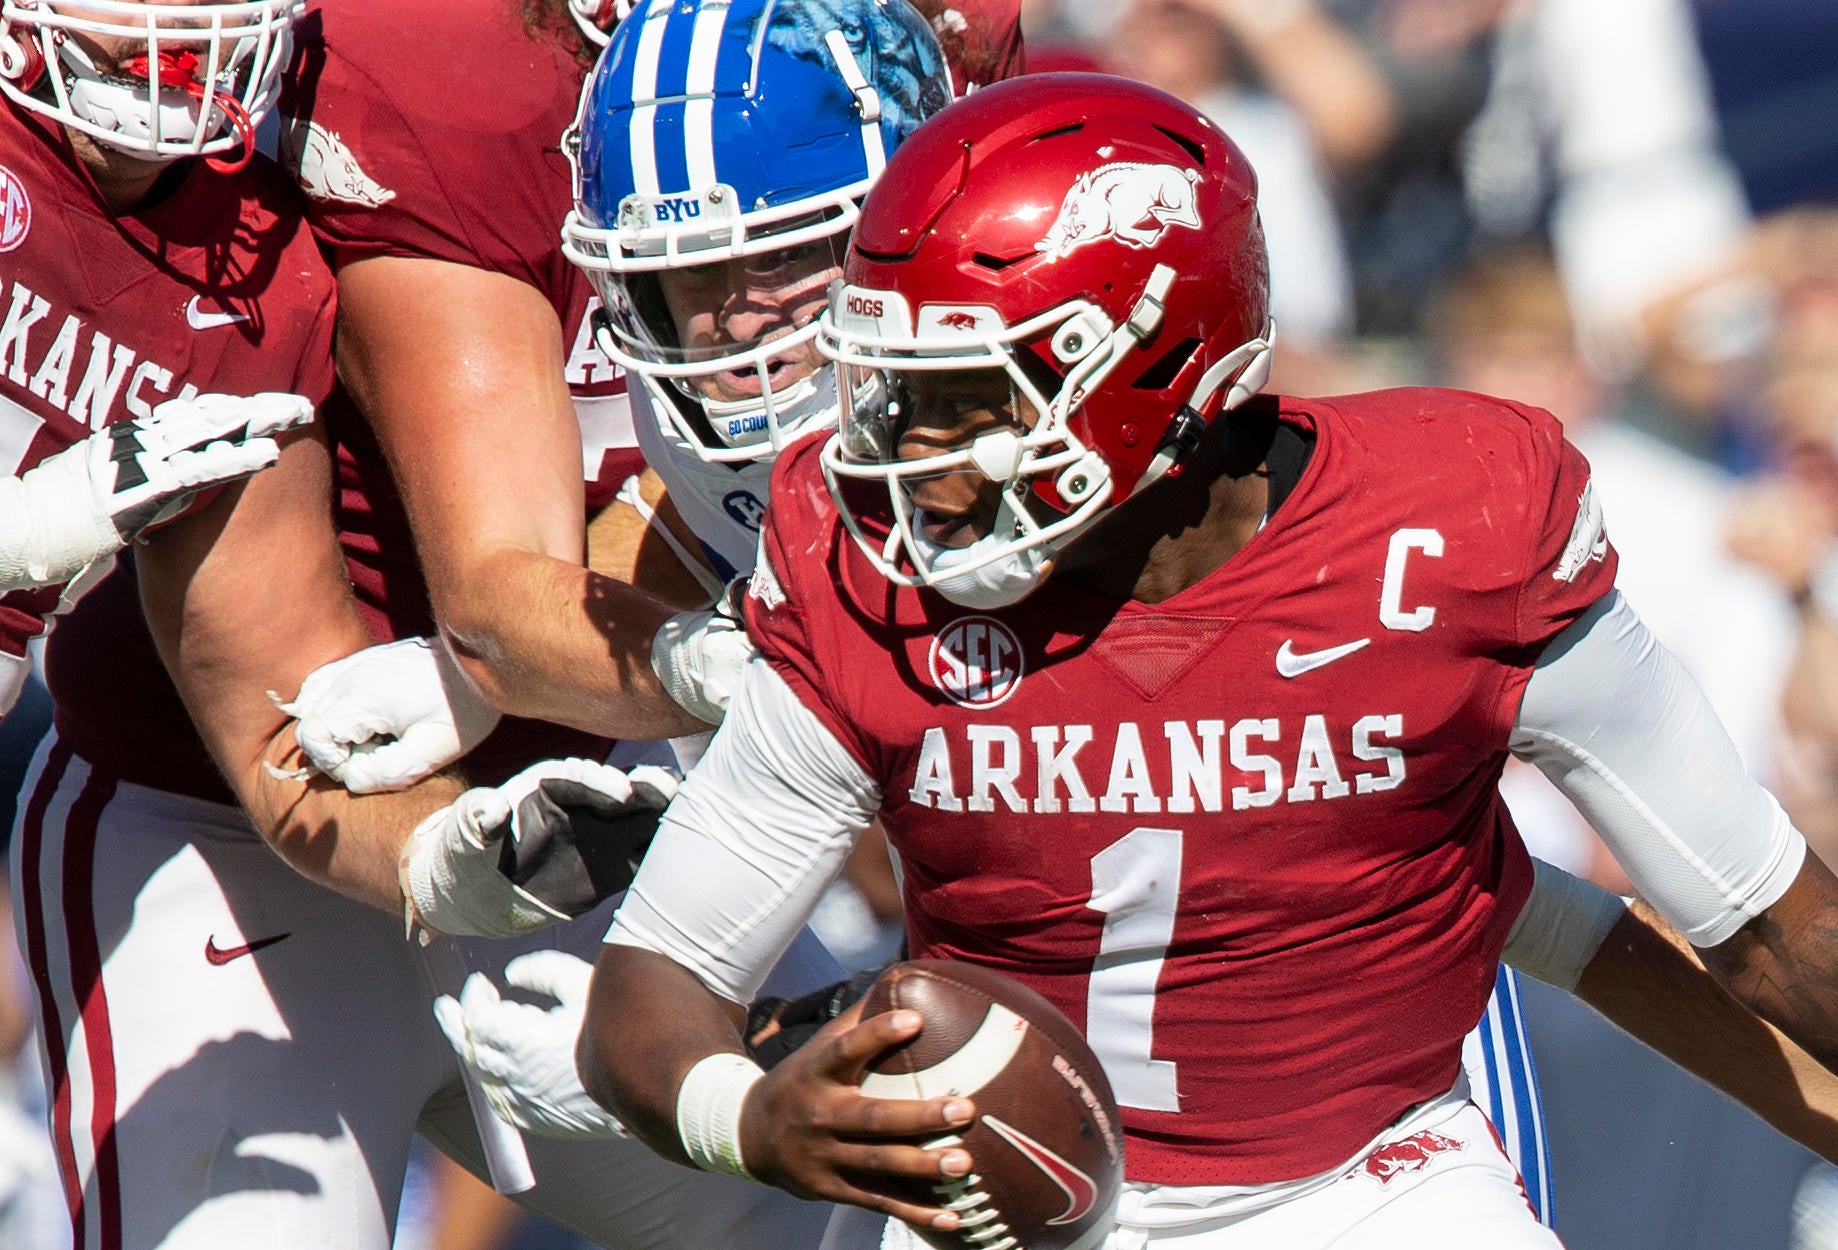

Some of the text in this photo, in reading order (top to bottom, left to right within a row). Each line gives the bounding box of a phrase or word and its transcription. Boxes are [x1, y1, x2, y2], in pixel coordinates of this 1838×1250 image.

[653, 198, 700, 222] BYU
[846, 294, 883, 318] HOGS
[1379, 527, 1444, 632] C
[940, 623, 1014, 700] SEC
[908, 713, 1406, 814] ARKANSAS
[1085, 826, 1183, 1114] 1
